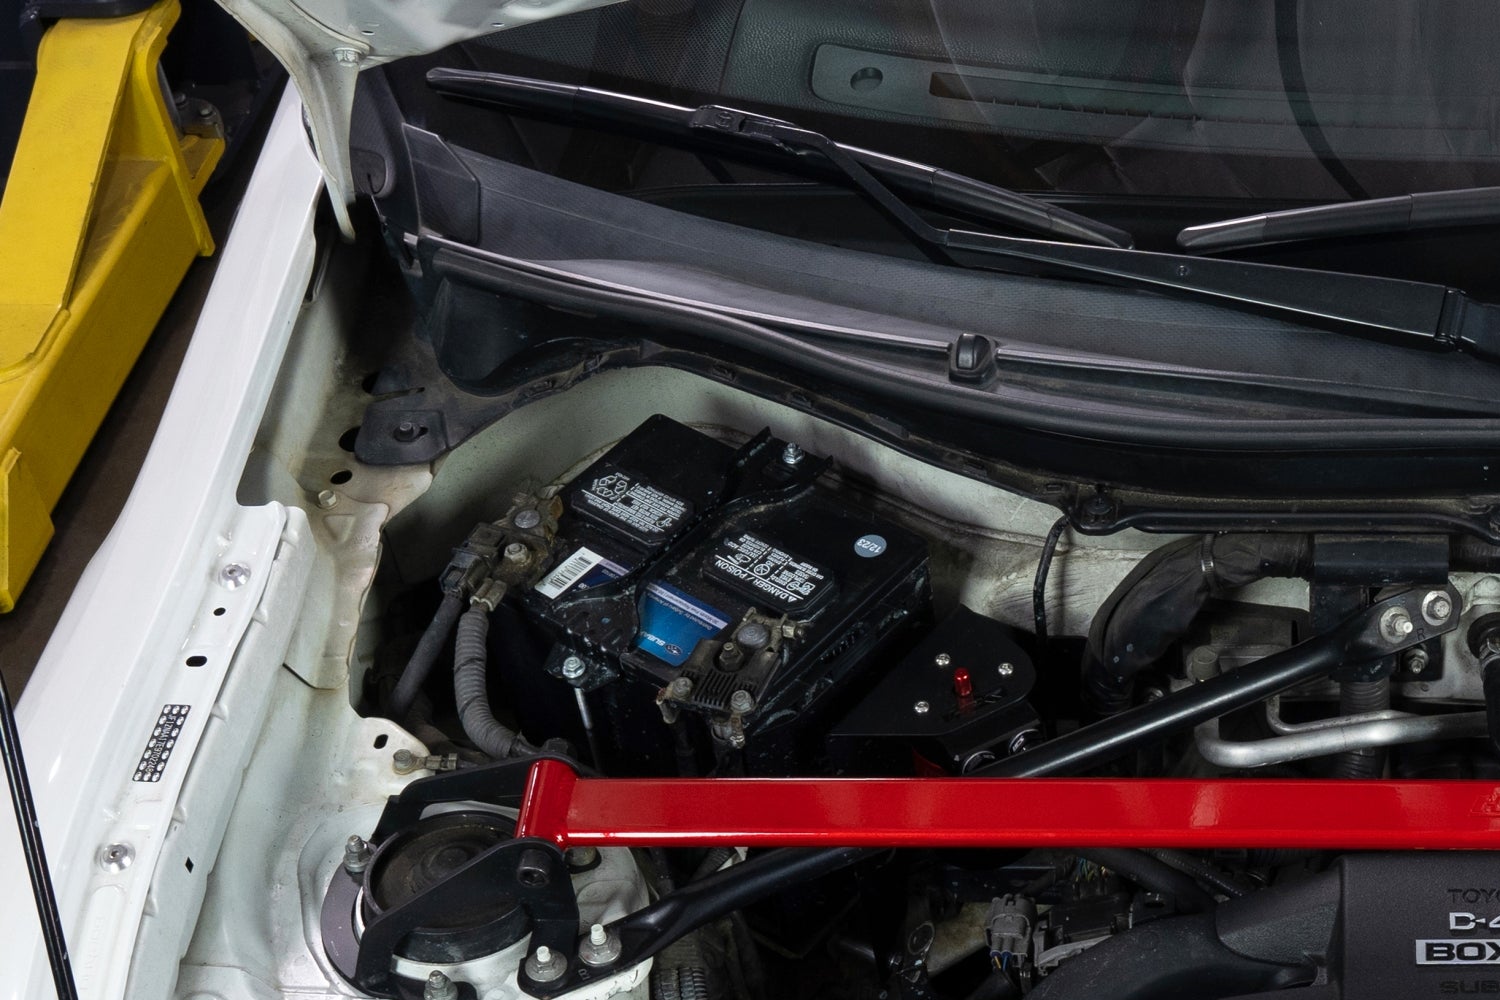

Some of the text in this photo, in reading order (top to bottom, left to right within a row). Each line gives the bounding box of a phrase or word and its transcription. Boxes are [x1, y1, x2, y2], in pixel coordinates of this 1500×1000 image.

[856, 538, 882, 553] 12/23
[714, 559, 747, 579] POISON
[753, 578, 788, 598] DANGER
[1417, 628, 1426, 640] R
